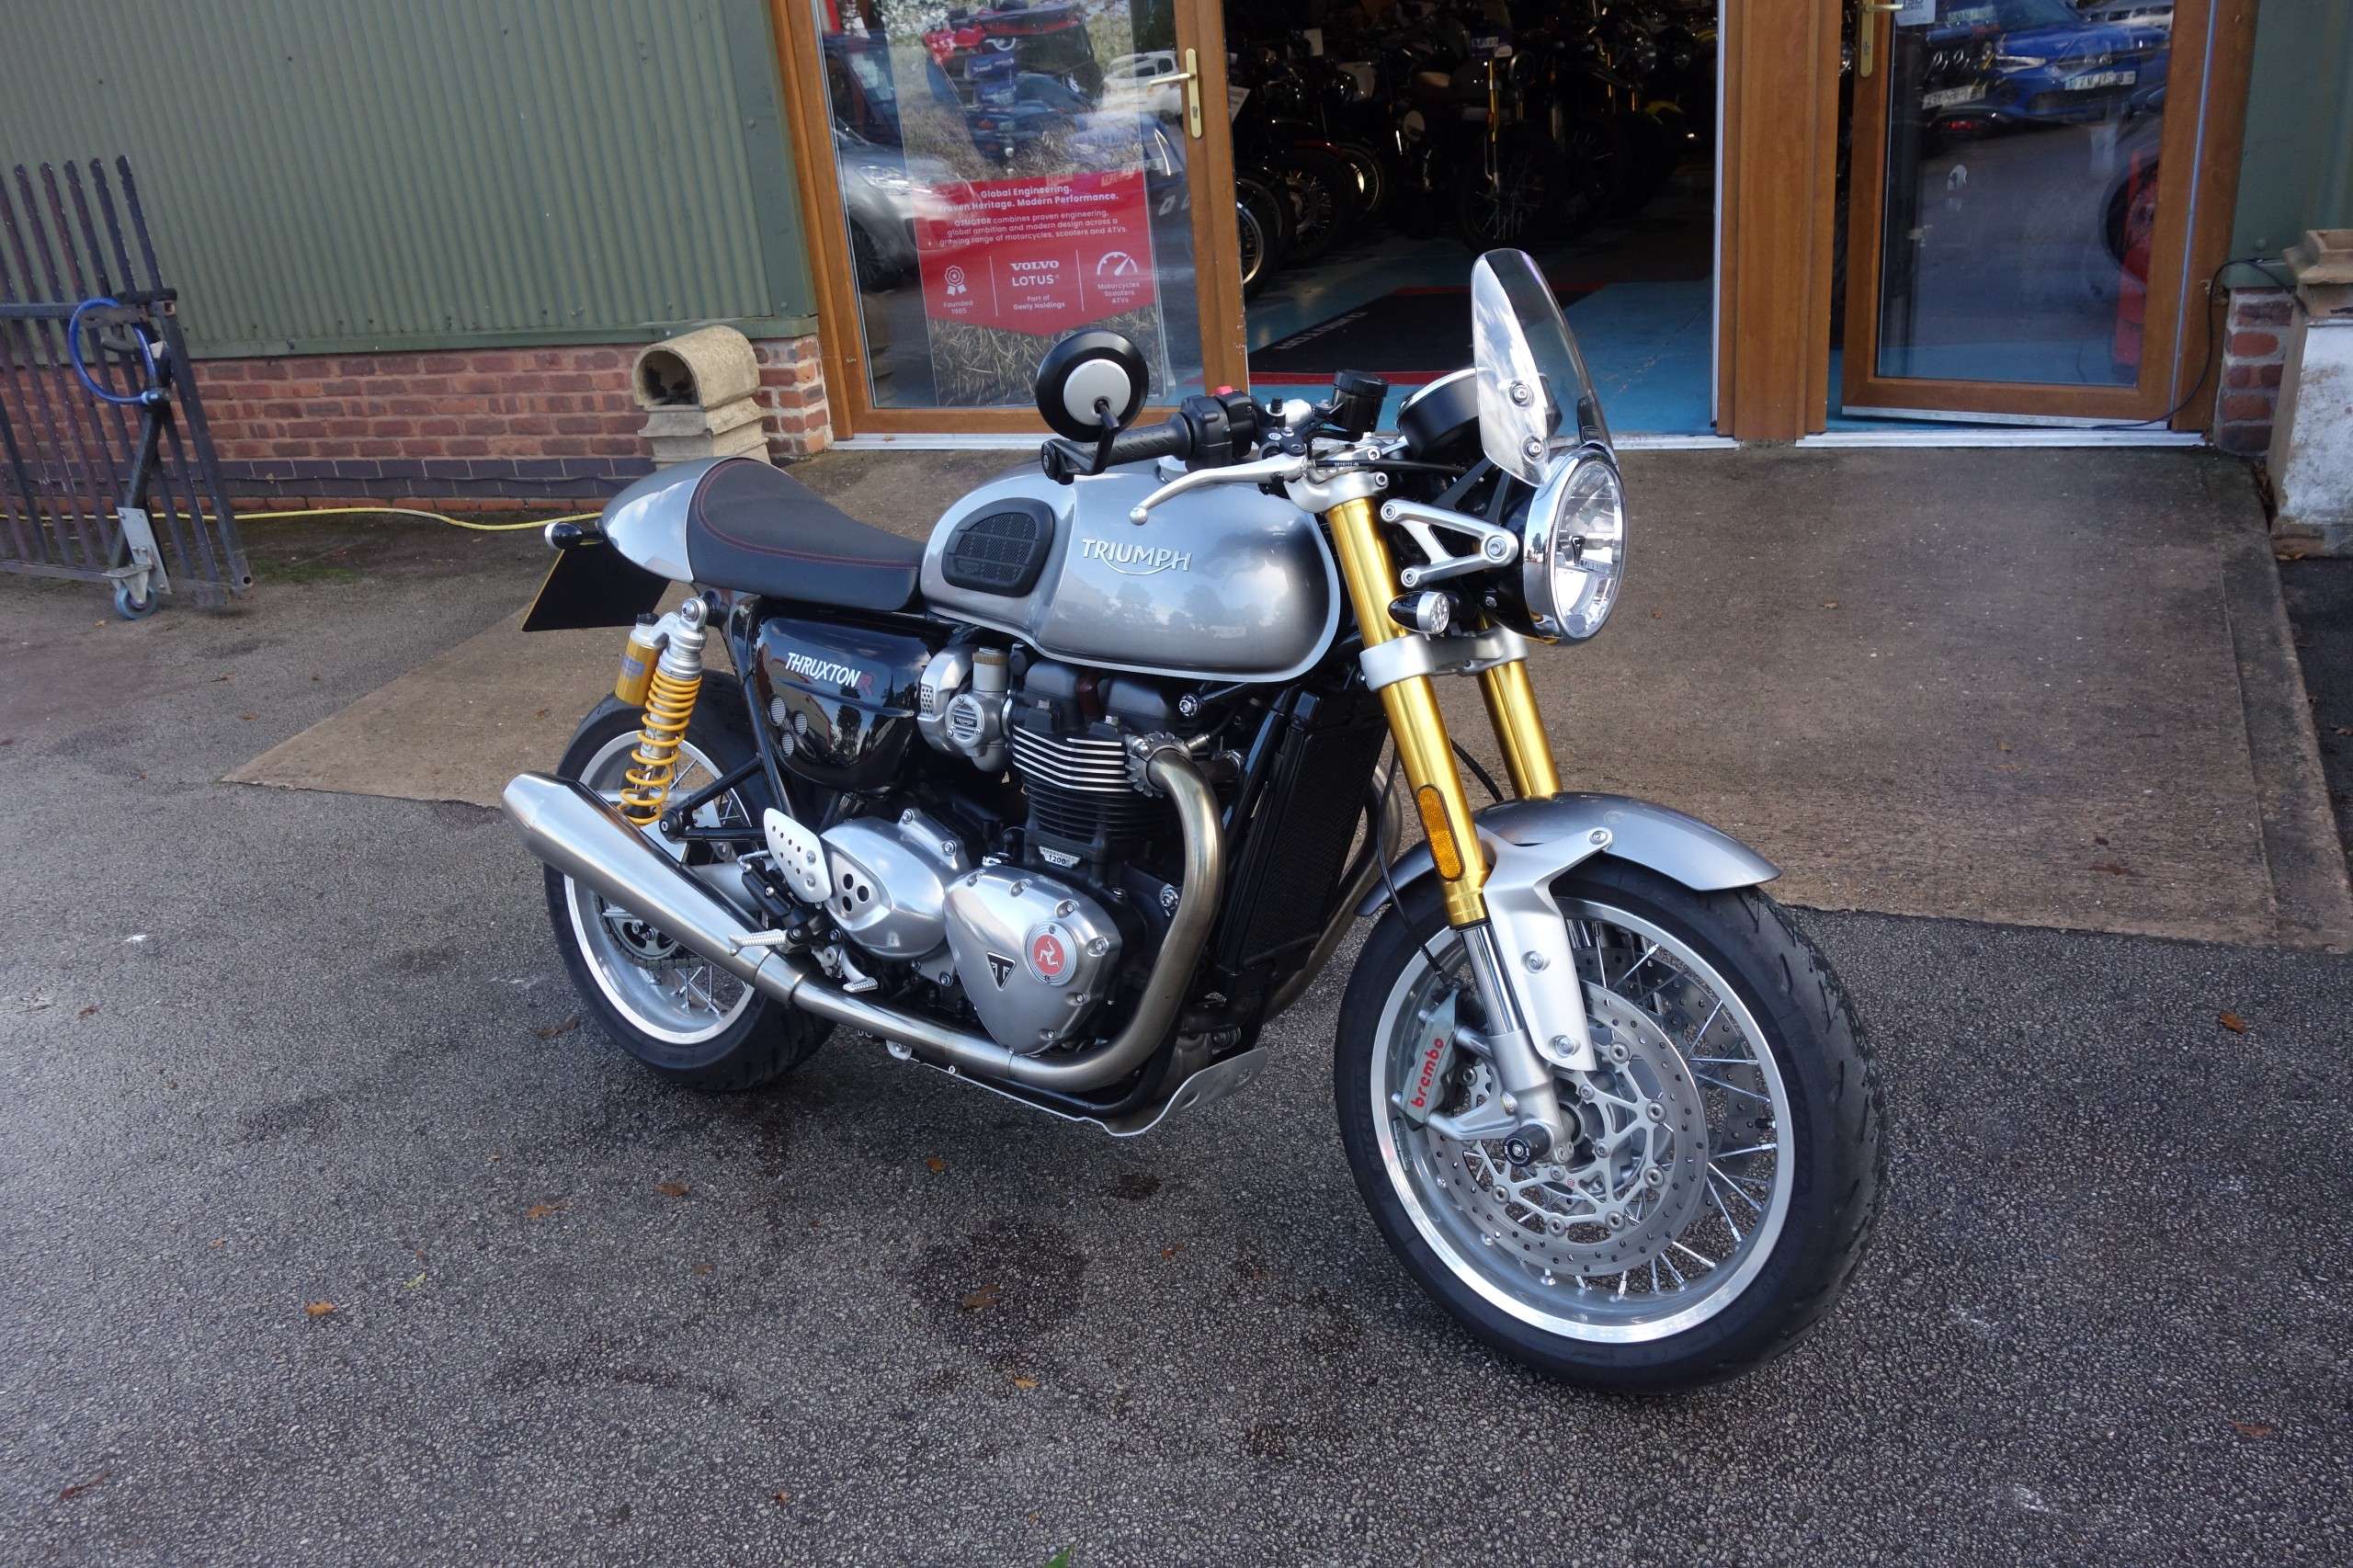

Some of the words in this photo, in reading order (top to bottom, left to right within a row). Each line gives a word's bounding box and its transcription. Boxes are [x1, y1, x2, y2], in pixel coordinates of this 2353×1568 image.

[980, 189, 1011, 199] Global
[1013, 187, 1073, 197] Engineering.
[972, 201, 1016, 211] Heritage.
[1017, 198, 1053, 207] Modern
[1054, 193, 1120, 204] Performance.
[993, 216, 1030, 224] combines
[1032, 213, 1059, 222] proven
[947, 230, 972, 238] global
[1026, 222, 1056, 231] modern
[1057, 220, 1084, 229] design
[939, 238, 971, 247] growing
[971, 237, 994, 245] range
[1055, 229, 1089, 237] scooters
[1010, 259, 1060, 272] VOLVO
[1012, 274, 1054, 288] LOTUS
[1097, 281, 1141, 291] Motorcycles
[943, 300, 973, 309] Founded
[1013, 303, 1034, 312] Geely
[1034, 301, 1066, 311] Holdings
[1082, 538, 1192, 574] TRIUMPH
[785, 652, 861, 688] THRUXTON
[858, 671, 877, 696] R
[1410, 1038, 1445, 1108] brembo
